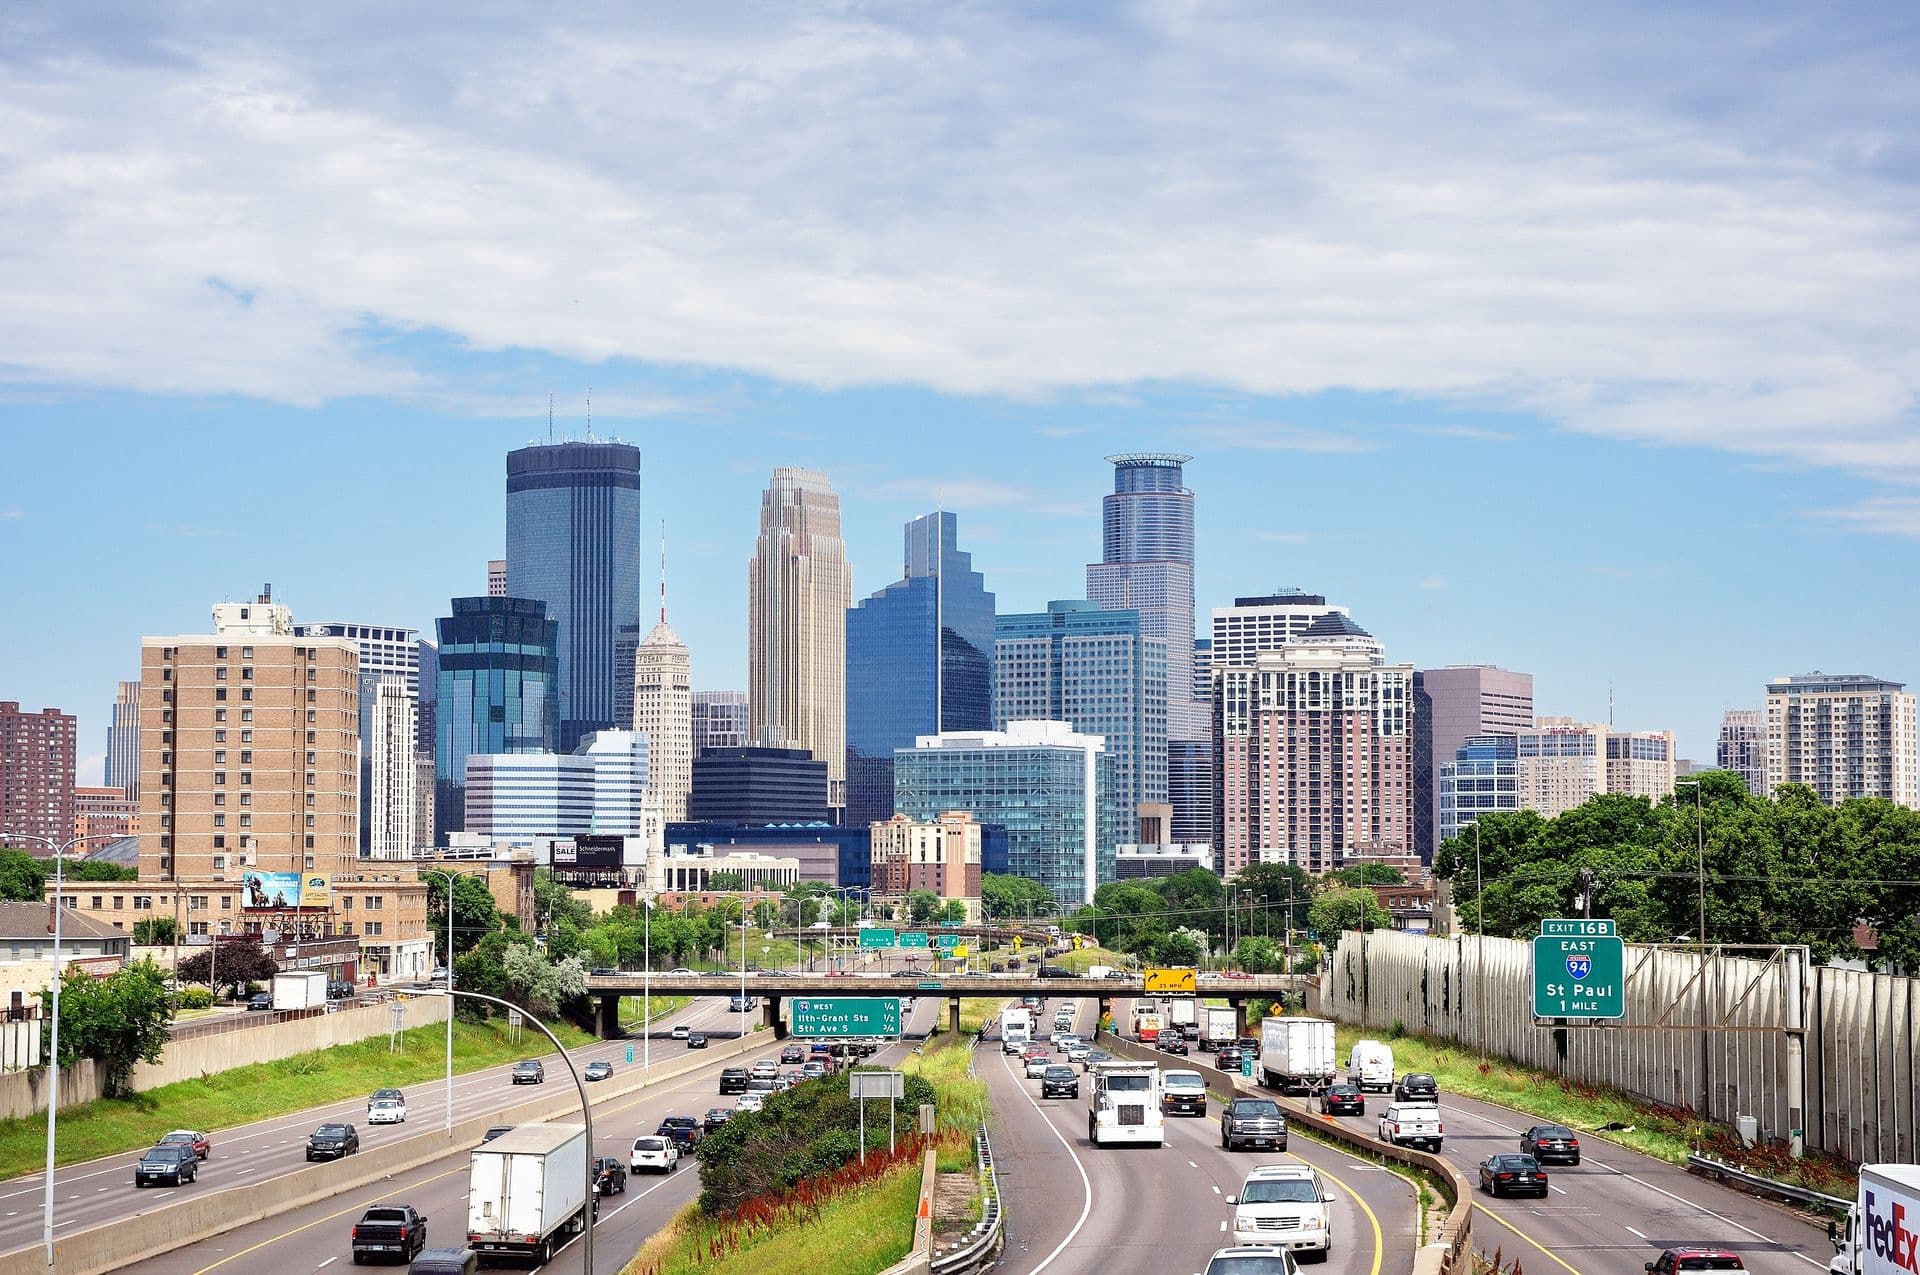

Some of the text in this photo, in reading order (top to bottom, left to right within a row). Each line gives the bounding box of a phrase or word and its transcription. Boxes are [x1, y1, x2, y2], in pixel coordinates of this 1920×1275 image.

[1549, 922, 1608, 934] EXIT 16B
[1561, 941, 1596, 951] EAST
[1569, 961, 1588, 974] 94
[1546, 984, 1612, 997] St Paul
[1560, 1000, 1598, 1012] 1 MILE
[798, 1014, 849, 1022] 11th-Grant
[853, 1014, 869, 1022] Sts
[798, 1024, 815, 1033] 5th
[820, 1024, 838, 1033] Ave
[842, 1024, 849, 1033] S
[1865, 1189, 1919, 1275] FedEx
